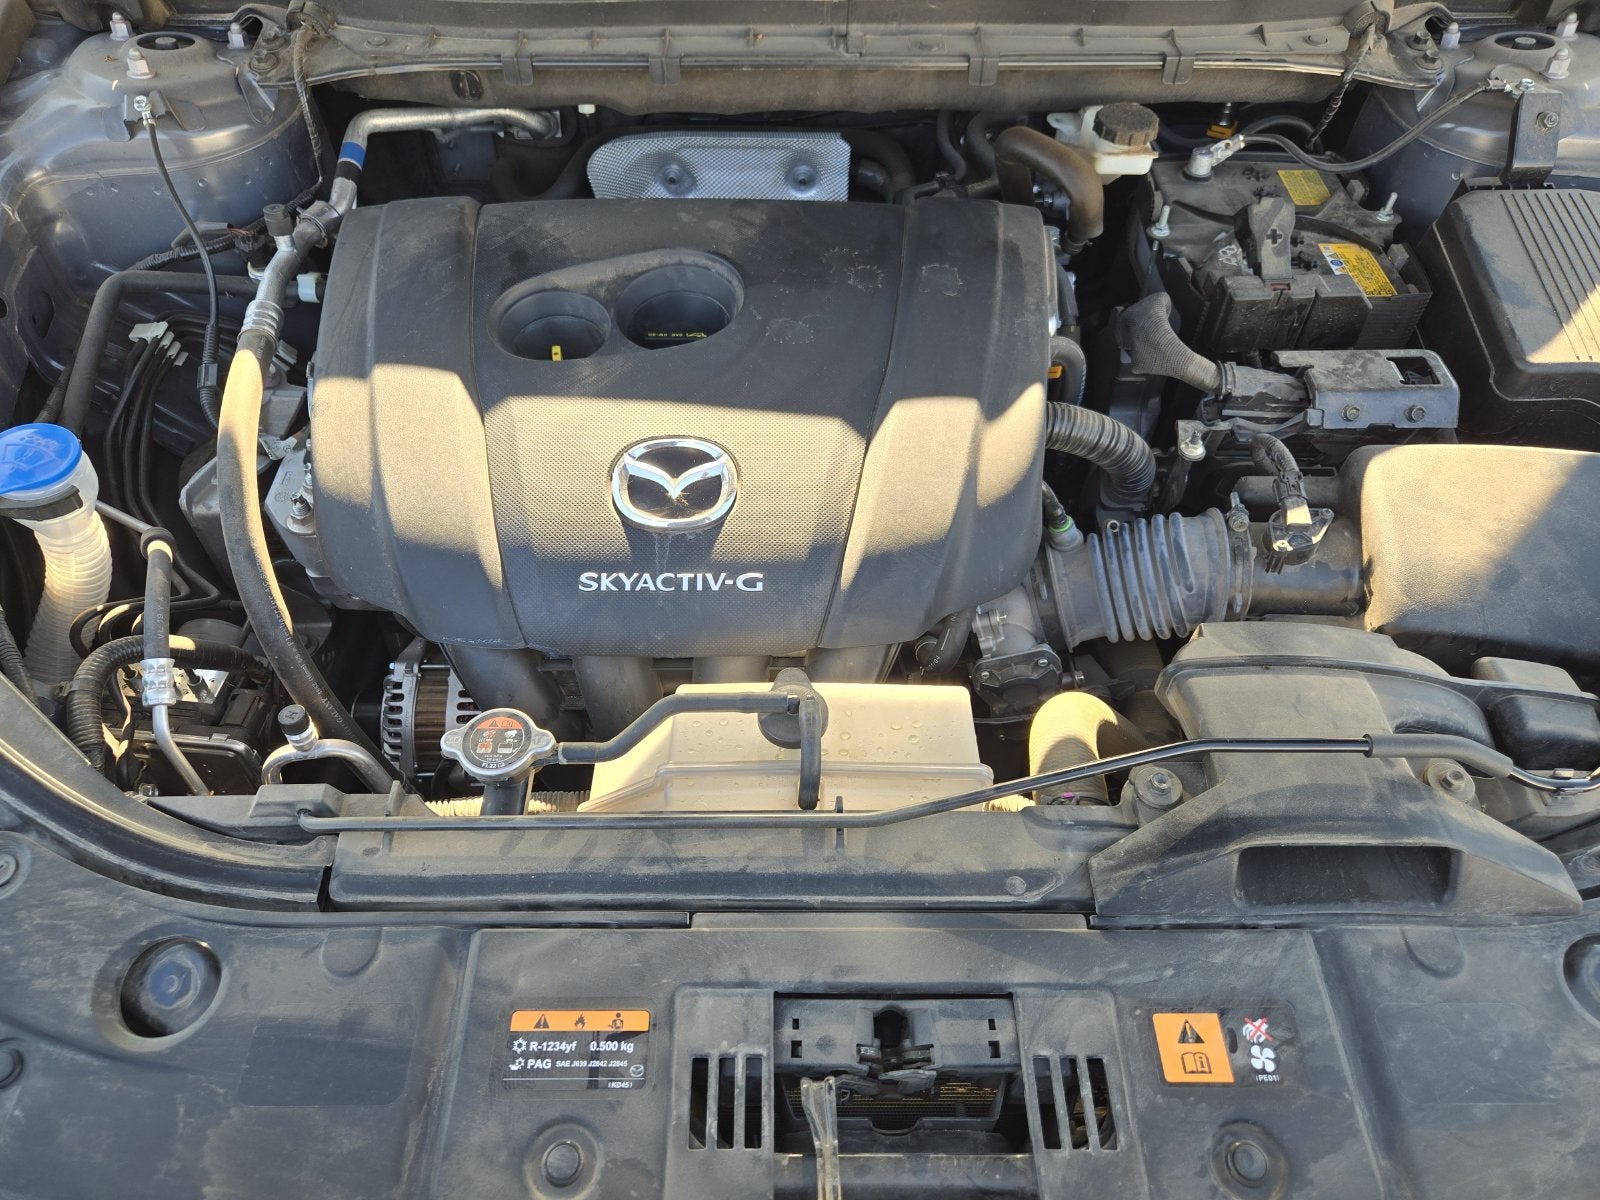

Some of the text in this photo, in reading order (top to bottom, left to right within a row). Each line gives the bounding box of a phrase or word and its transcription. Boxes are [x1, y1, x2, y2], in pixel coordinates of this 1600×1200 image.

[578, 572, 764, 592] SKYACTIV-G
[529, 1041, 634, 1053] R-1234yf 0.500 kg
[527, 1059, 552, 1069] PAG
